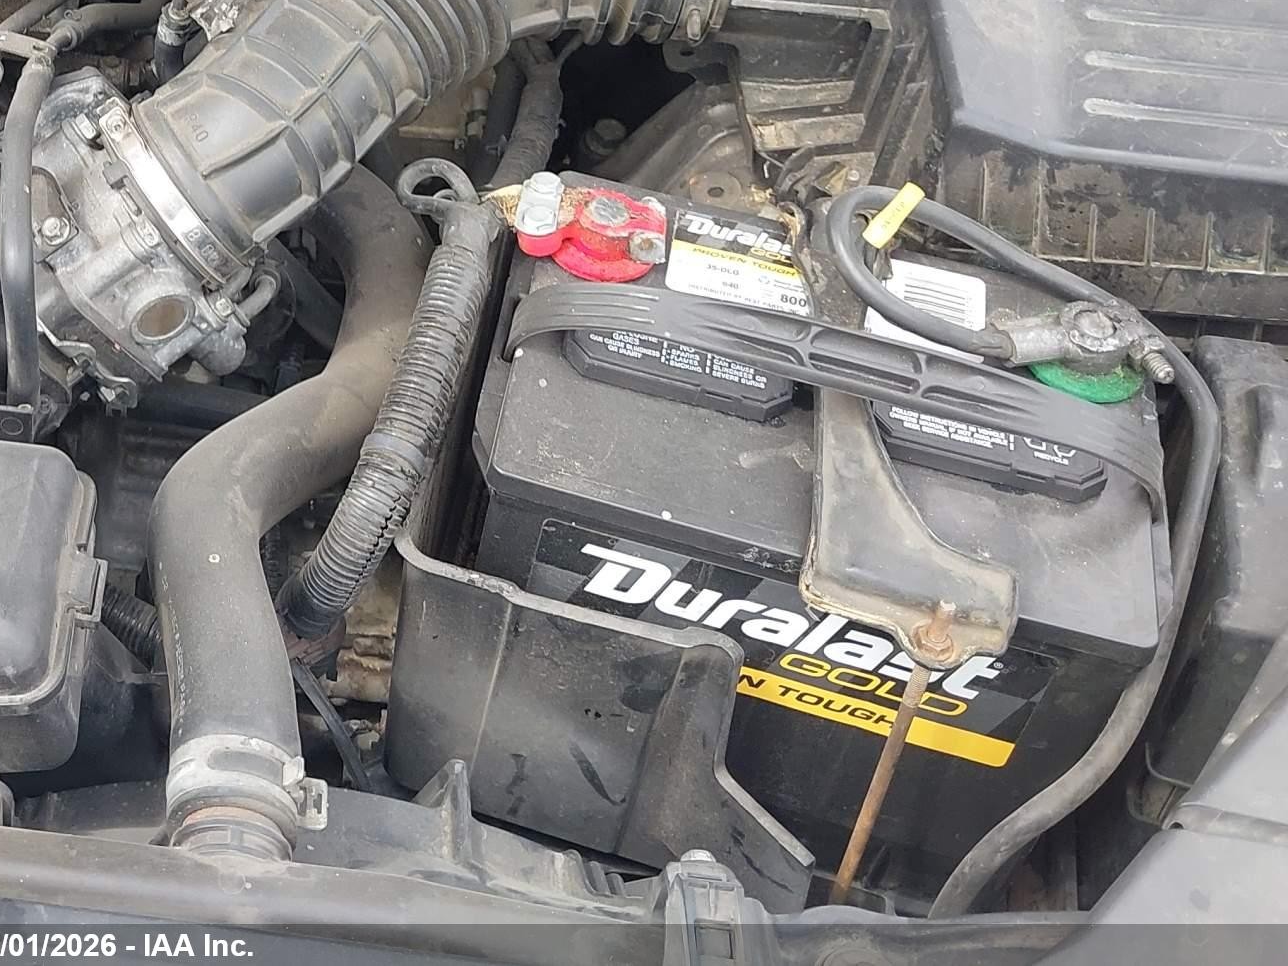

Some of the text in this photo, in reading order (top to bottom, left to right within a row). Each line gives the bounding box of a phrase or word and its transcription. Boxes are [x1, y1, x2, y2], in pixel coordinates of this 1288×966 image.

[685, 213, 793, 257] Duralas
[693, 247, 747, 264] PROVEN
[780, 293, 807, 308] 800
[669, 360, 703, 373] SMOKING
[712, 364, 768, 383] BLINDNESS OR
[713, 358, 754, 374] CAN CAUSE
[712, 370, 766, 389] SEVERE BURNS
[973, 432, 1008, 446] AVAILABLE
[1033, 450, 1069, 466] RECYCLE
[778, 652, 969, 717] GOLD
[778, 684, 896, 730] TOUGH
